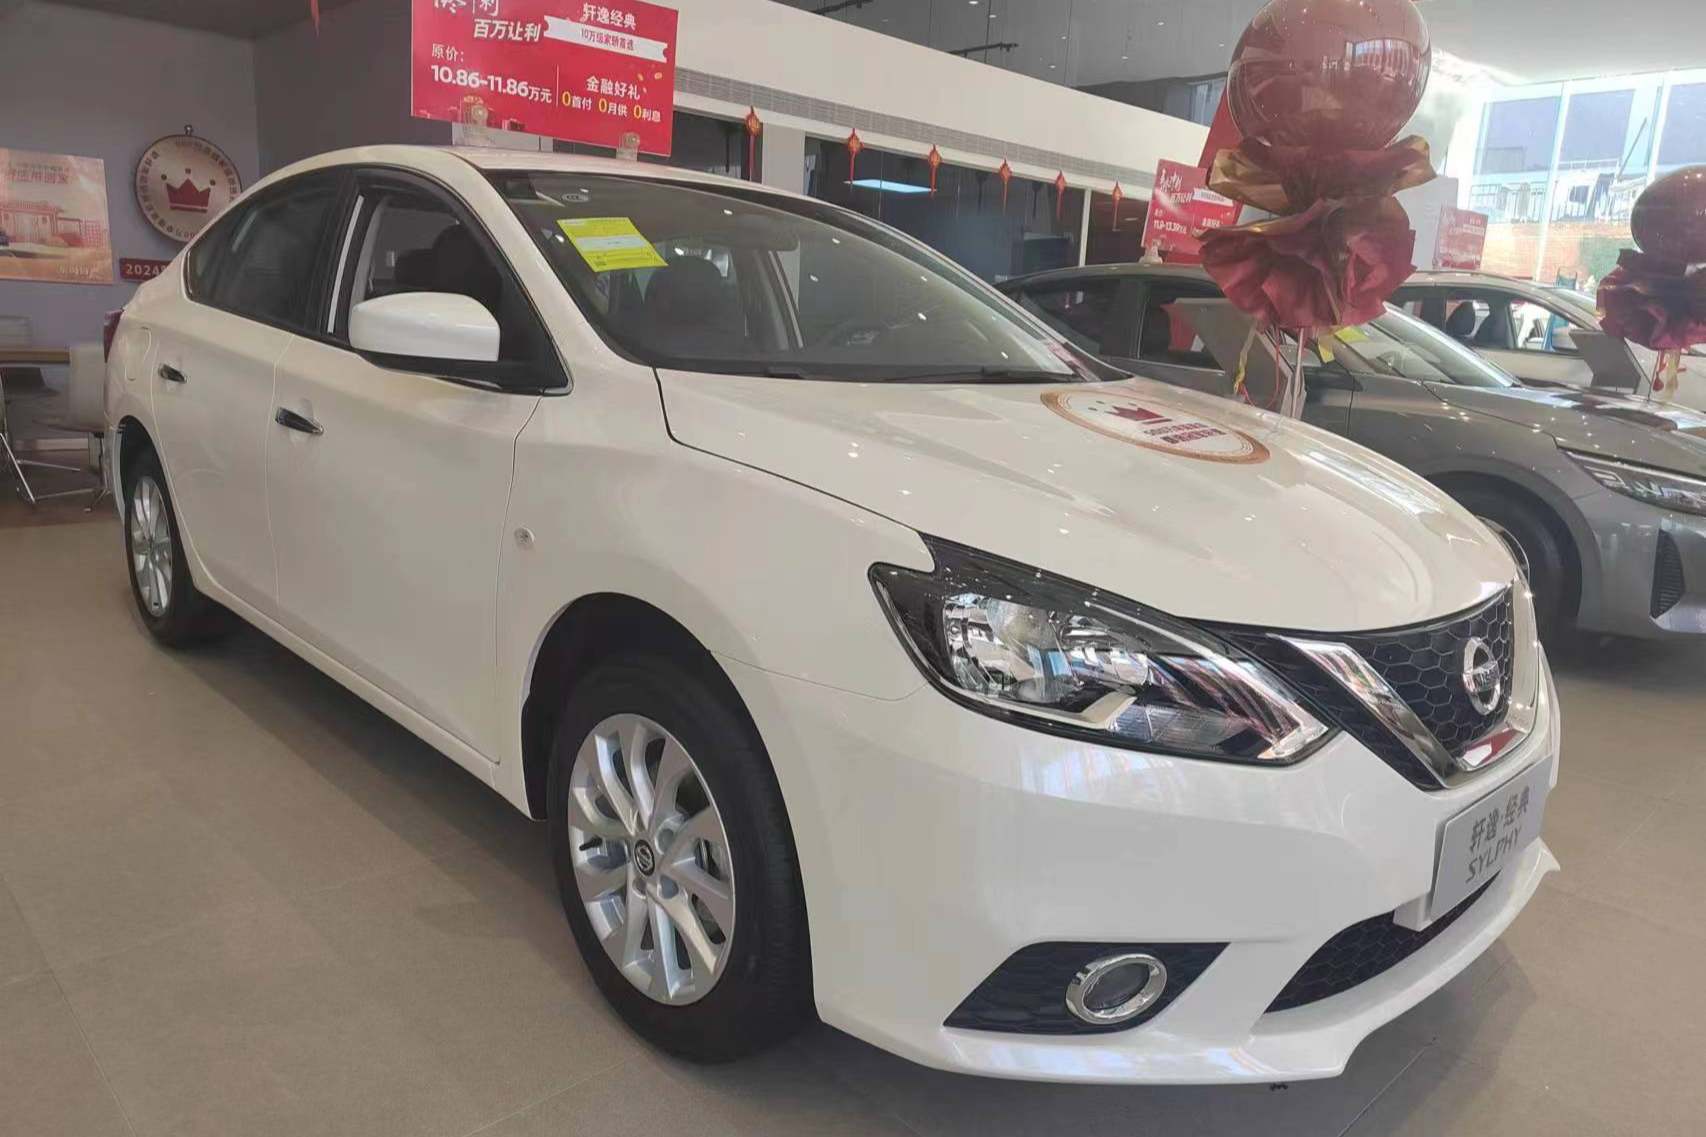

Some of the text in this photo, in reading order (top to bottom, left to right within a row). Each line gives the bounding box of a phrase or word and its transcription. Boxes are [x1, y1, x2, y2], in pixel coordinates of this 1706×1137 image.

[473, 18, 541, 41] 百万让利
[431, 65, 552, 103] 10.86-11.86万元
[586, 75, 640, 100] 金融好礼
[562, 91, 661, 123] 0首付 0月供 0利息
[1465, 825, 1522, 884] SYLPHY
